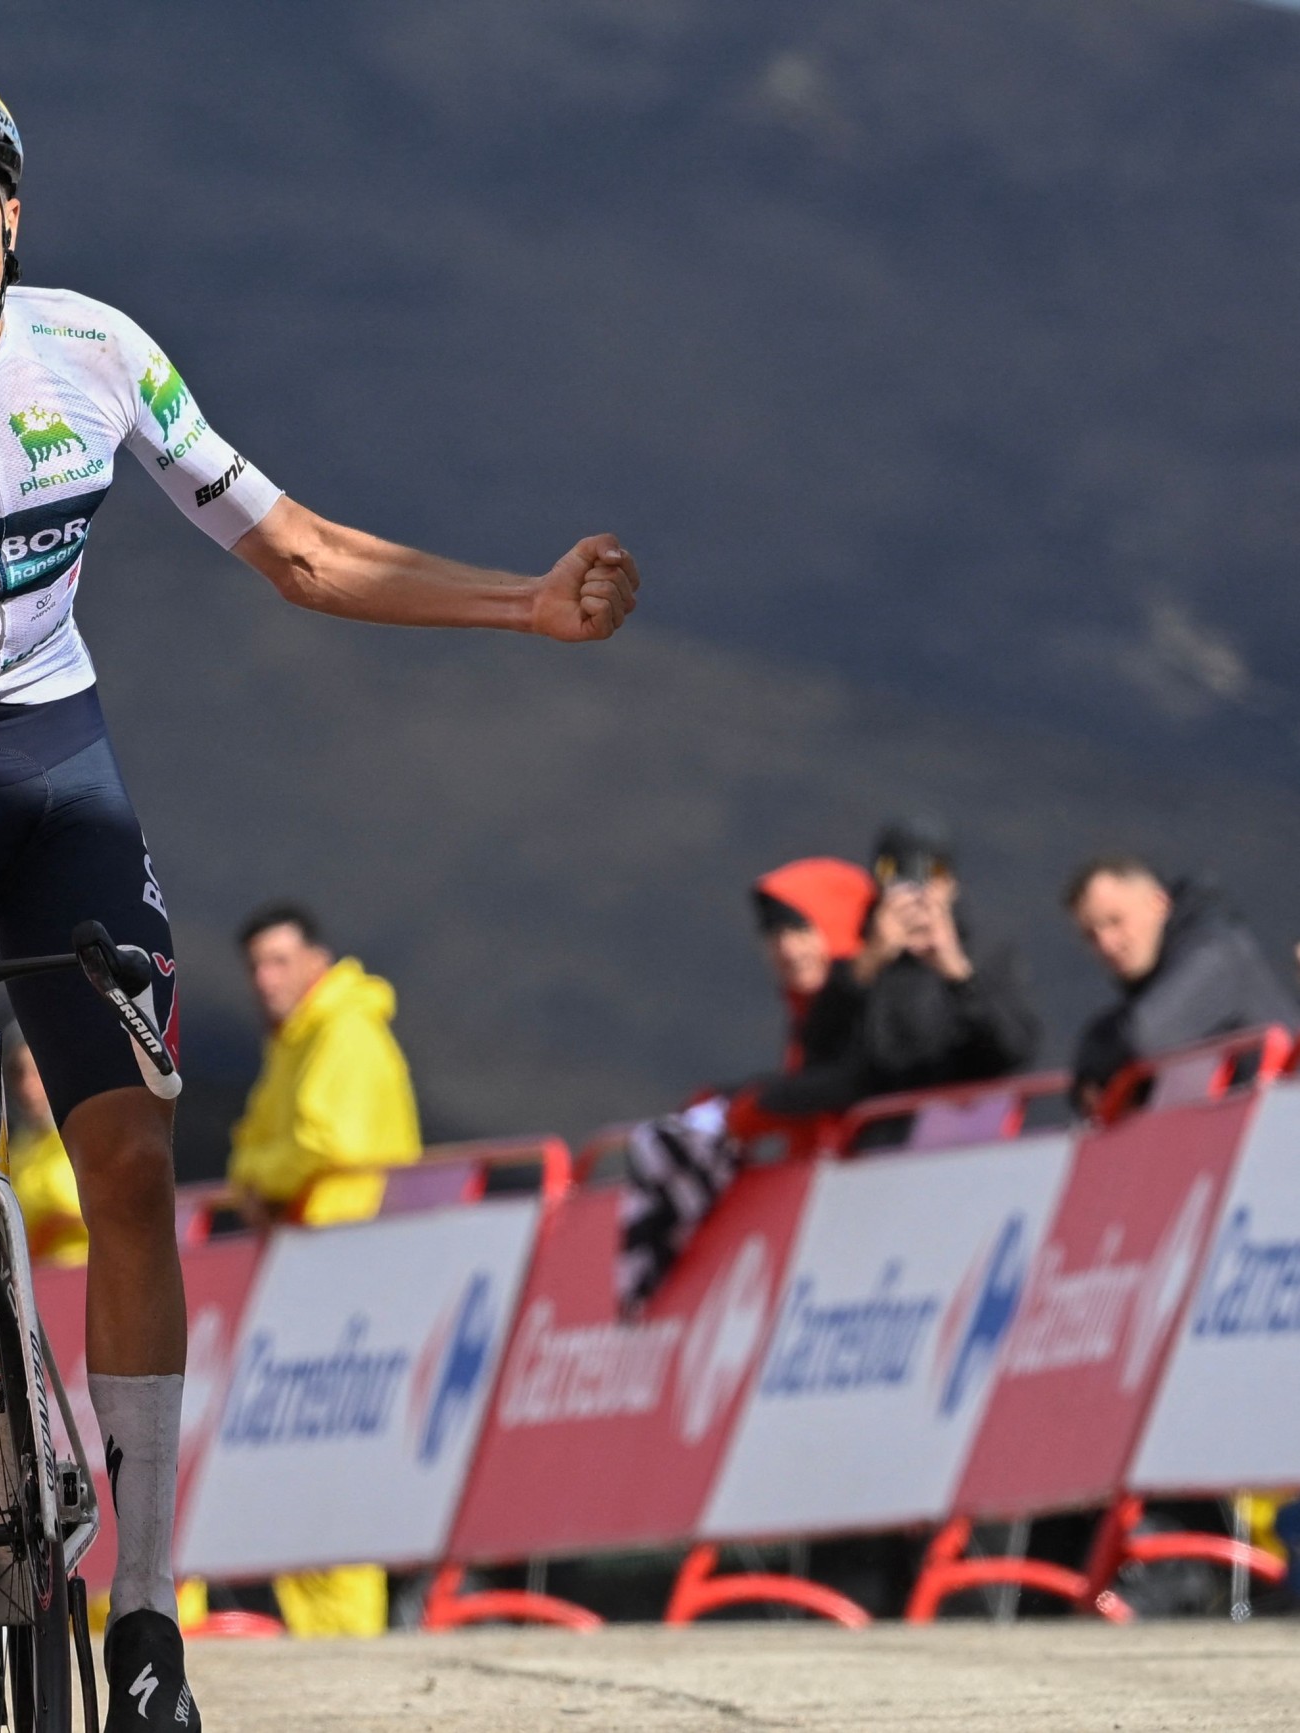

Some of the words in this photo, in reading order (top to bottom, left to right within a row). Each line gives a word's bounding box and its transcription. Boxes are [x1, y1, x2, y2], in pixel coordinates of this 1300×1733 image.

[31, 324, 107, 341] plenitude
[156, 416, 207, 470] plenit
[19, 458, 104, 496] plenitude
[195, 452, 247, 507] Sant
[2, 517, 88, 562] BOR
[108, 988, 163, 1054] SRAM
